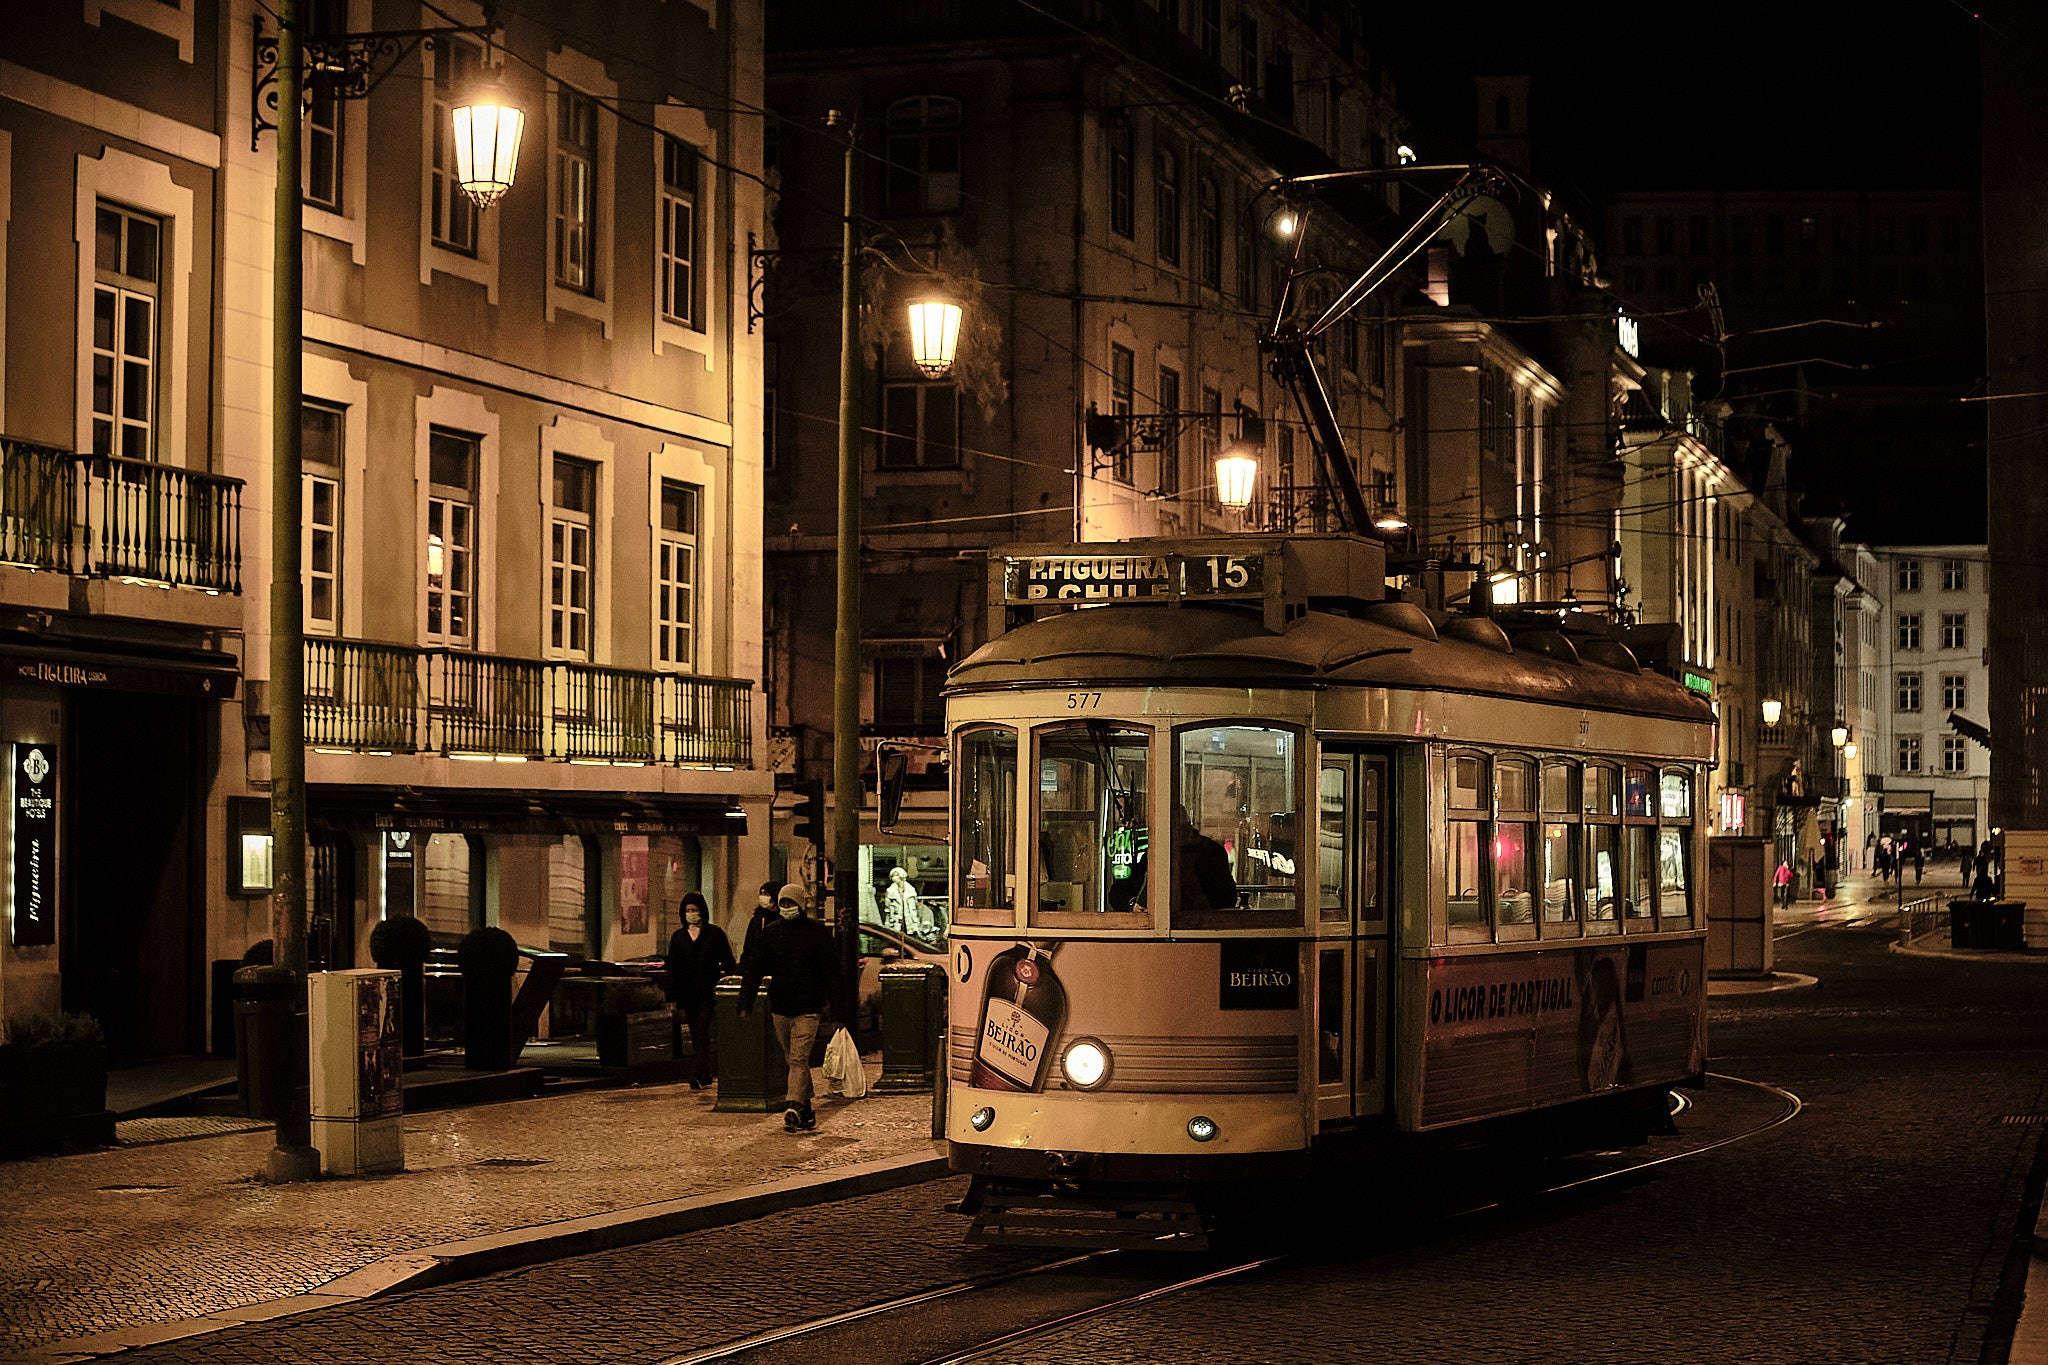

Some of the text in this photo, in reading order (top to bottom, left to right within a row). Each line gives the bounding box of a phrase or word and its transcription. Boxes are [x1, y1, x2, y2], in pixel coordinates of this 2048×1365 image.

[1206, 558, 1249, 588] 15
[38, 662, 88, 686] FIGUEIRA
[1067, 692, 1102, 709] 577
[1230, 970, 1291, 987] BEIRÃO
[1431, 977, 1573, 1024] O LICOR DE PORTUGAL
[987, 1019, 1037, 1062] BEIRÃO
